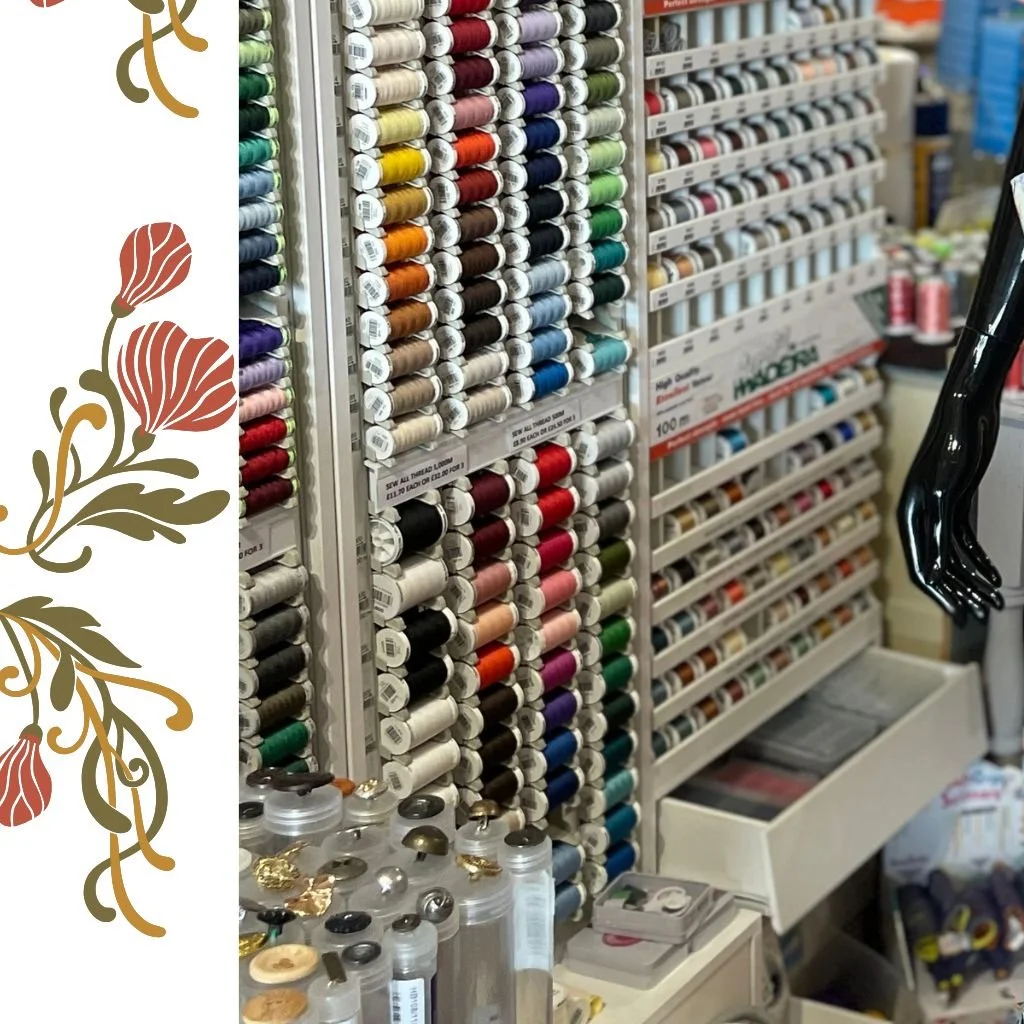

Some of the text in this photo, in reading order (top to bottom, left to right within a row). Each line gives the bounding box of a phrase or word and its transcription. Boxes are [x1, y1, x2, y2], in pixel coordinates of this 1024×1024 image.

[656, 416, 677, 438] 100
[385, 479, 398, 490] SEW
[400, 475, 409, 484] ALL
[410, 465, 433, 480] THREAD
[406, 482, 420, 493] EACH
[421, 477, 430, 486] OR
[449, 463, 460, 473] FOR
[244, 545, 257, 557] FOR
